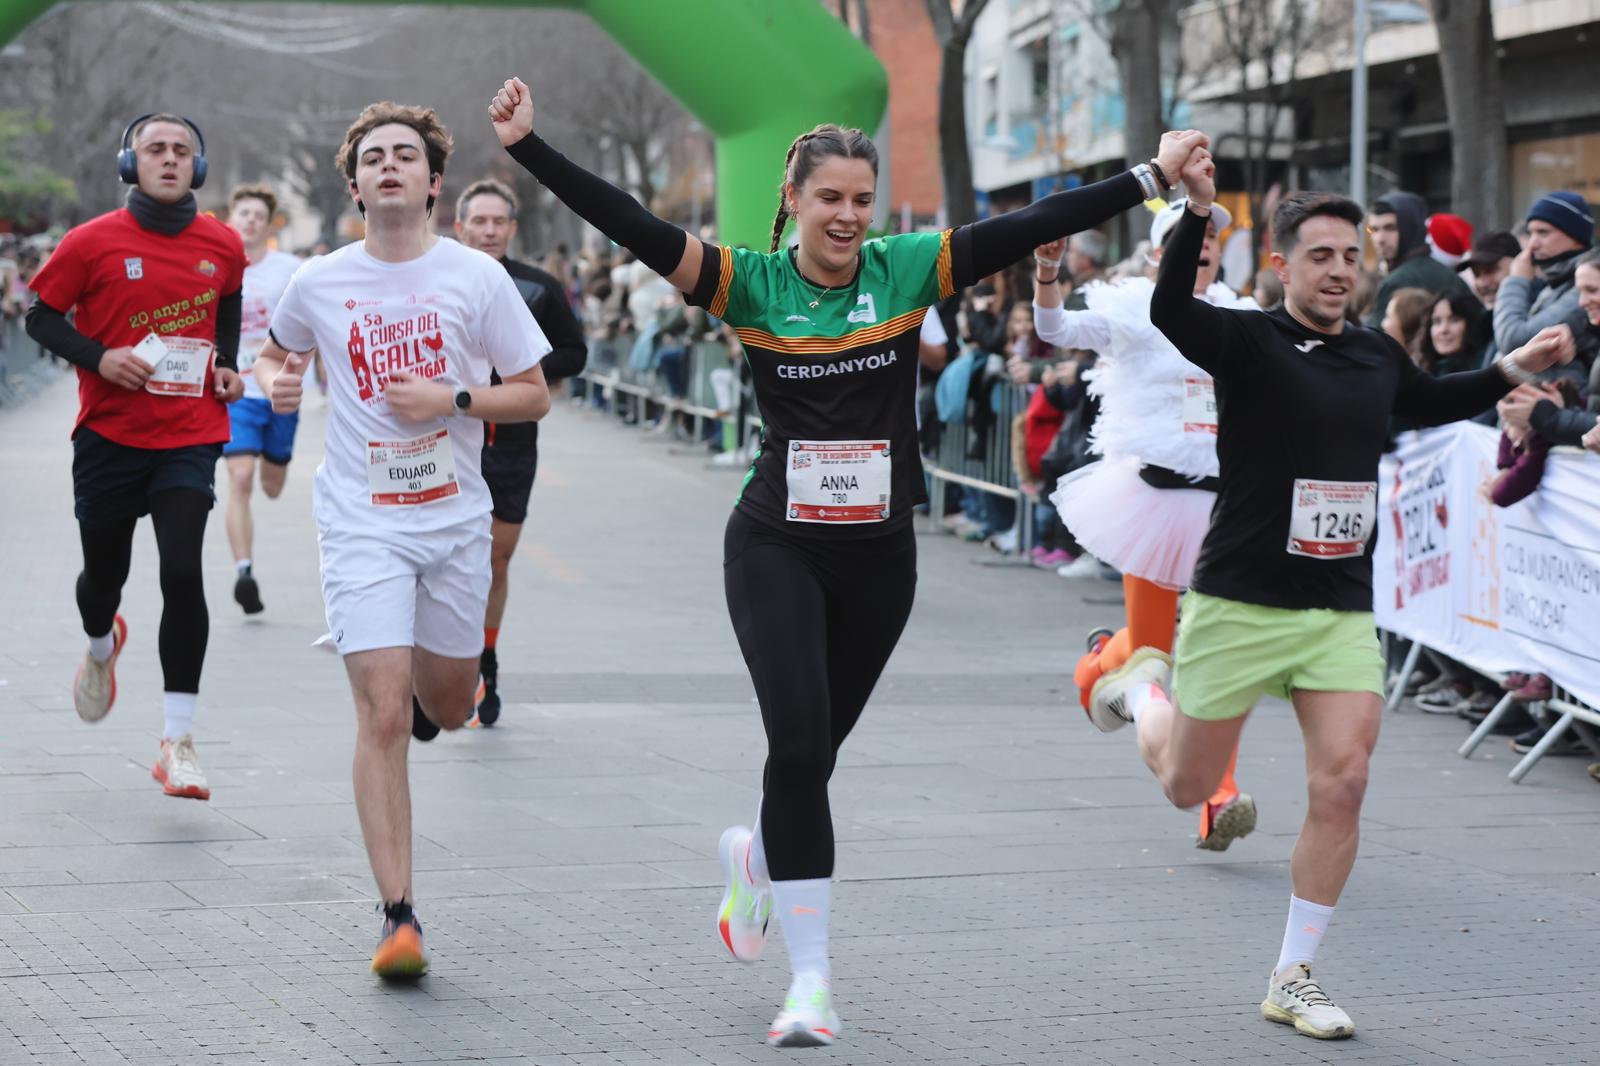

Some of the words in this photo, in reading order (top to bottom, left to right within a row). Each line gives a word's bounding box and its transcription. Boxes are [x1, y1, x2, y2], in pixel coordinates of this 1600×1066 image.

[129, 311, 149, 329] 20
[153, 299, 191, 319] anys
[194, 288, 217, 305] amb
[363, 313, 383, 328] 5a
[148, 309, 208, 335] l'escola
[370, 319, 414, 348] CURSA
[418, 312, 440, 334] DEL
[371, 338, 426, 376] GALL
[777, 350, 897, 379] CERDANYOLA
[388, 462, 437, 480] EDUARD
[820, 475, 859, 490] ANNA
[408, 480, 422, 490] 403
[831, 493, 848, 504] 780
[1311, 511, 1363, 539] 1246
